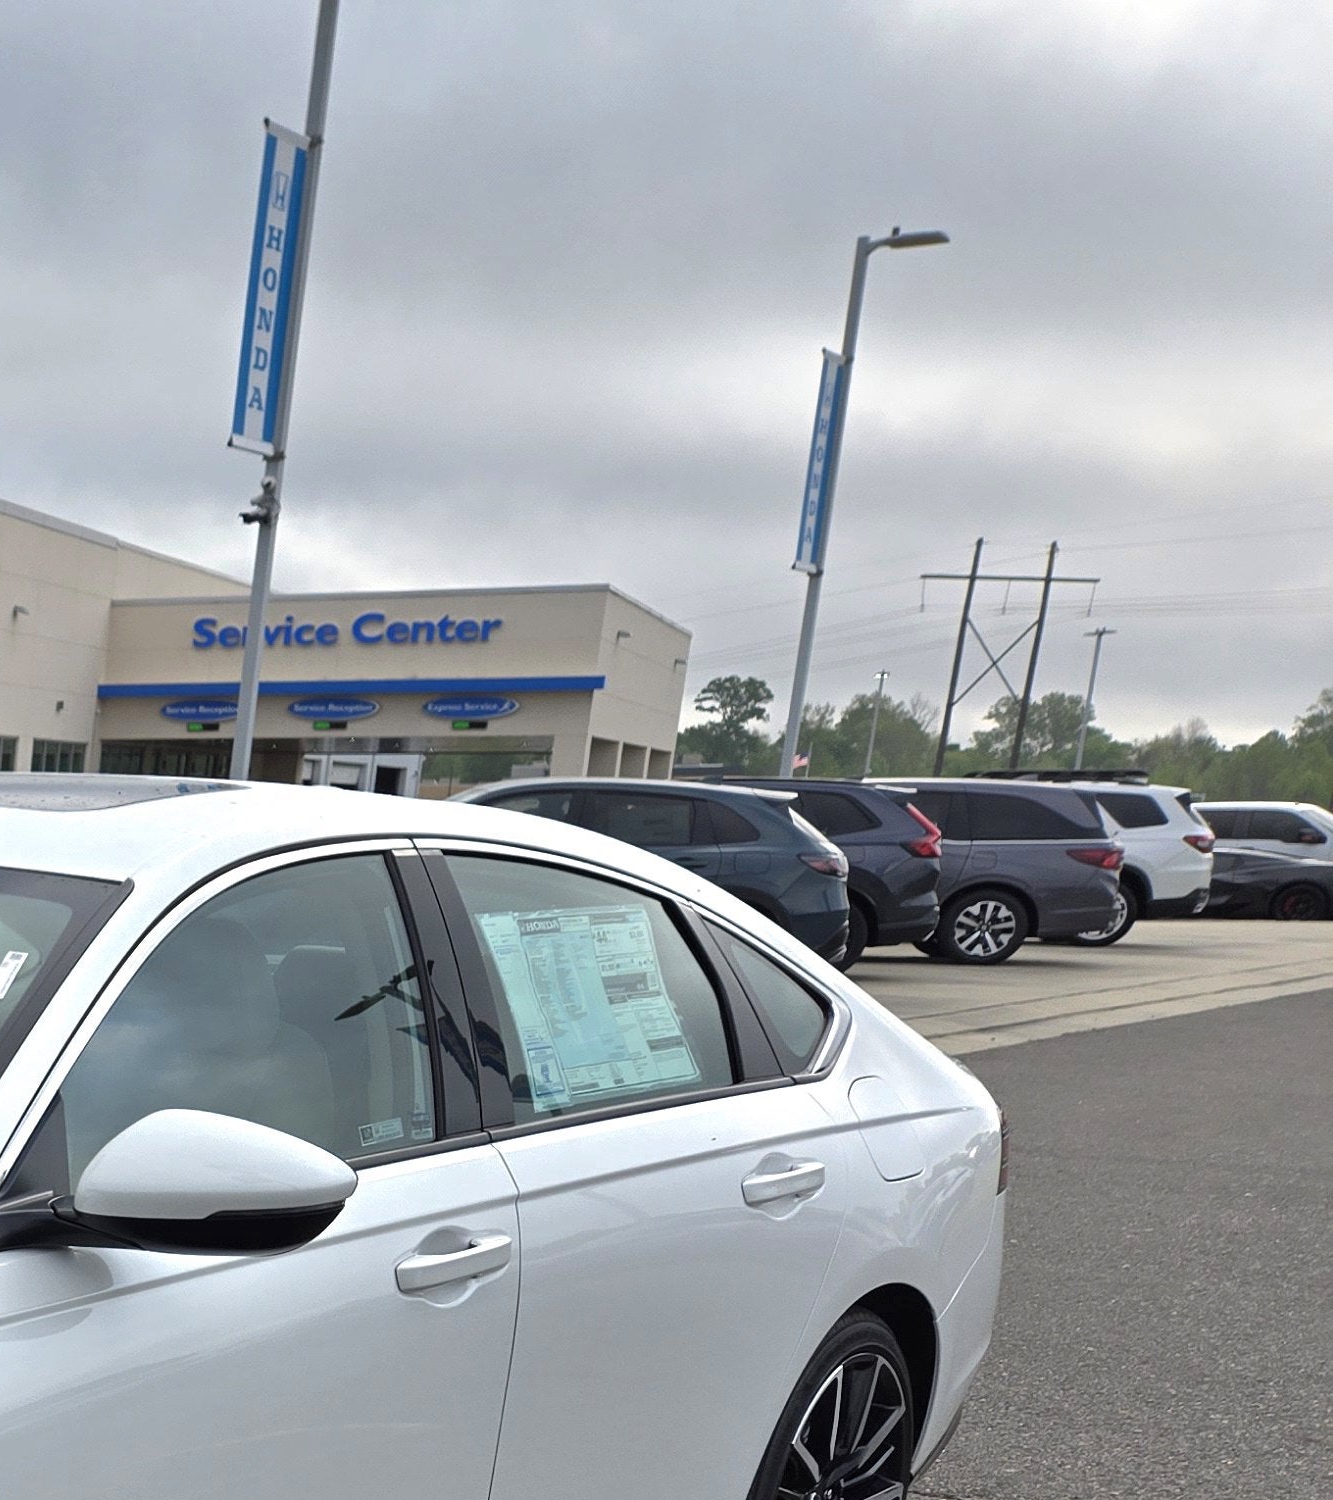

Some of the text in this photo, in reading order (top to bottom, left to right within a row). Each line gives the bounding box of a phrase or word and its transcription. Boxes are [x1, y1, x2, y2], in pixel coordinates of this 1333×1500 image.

[248, 225, 284, 411] HONDA
[805, 418, 829, 543] HONDA
[351, 612, 503, 644] Center
[293, 703, 327, 713] Service
